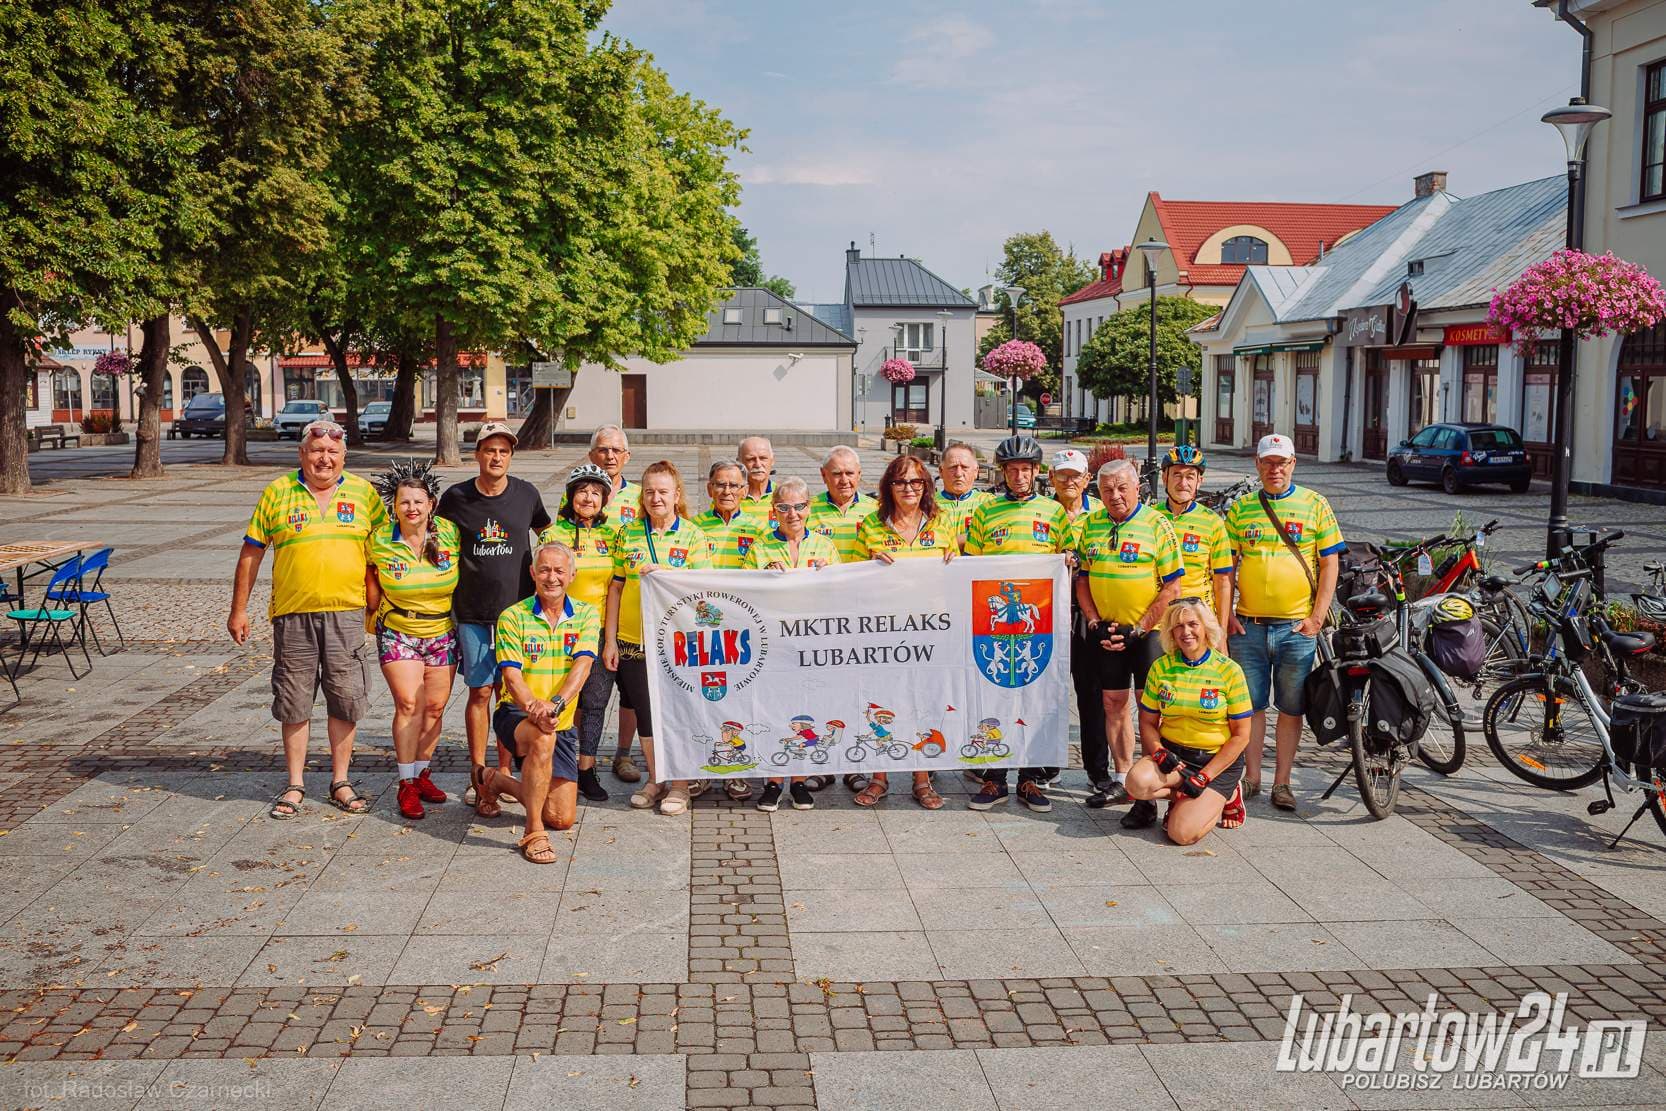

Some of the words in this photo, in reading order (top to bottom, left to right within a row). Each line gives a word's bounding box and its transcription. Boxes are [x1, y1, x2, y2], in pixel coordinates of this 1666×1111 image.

[473, 543, 513, 556] Lubartów
[661, 592, 704, 627] TURYSTYKI
[707, 590, 761, 625] ROWEROWEJ
[779, 616, 852, 637] MKTR
[858, 613, 951, 633] RELAKS
[759, 625, 767, 635] W
[674, 629, 752, 668] RELAKS
[734, 636, 769, 692] LUBARTOWIE
[798, 641, 935, 667] LUBARTÓW
[659, 656, 695, 693] MIEJSKIE
